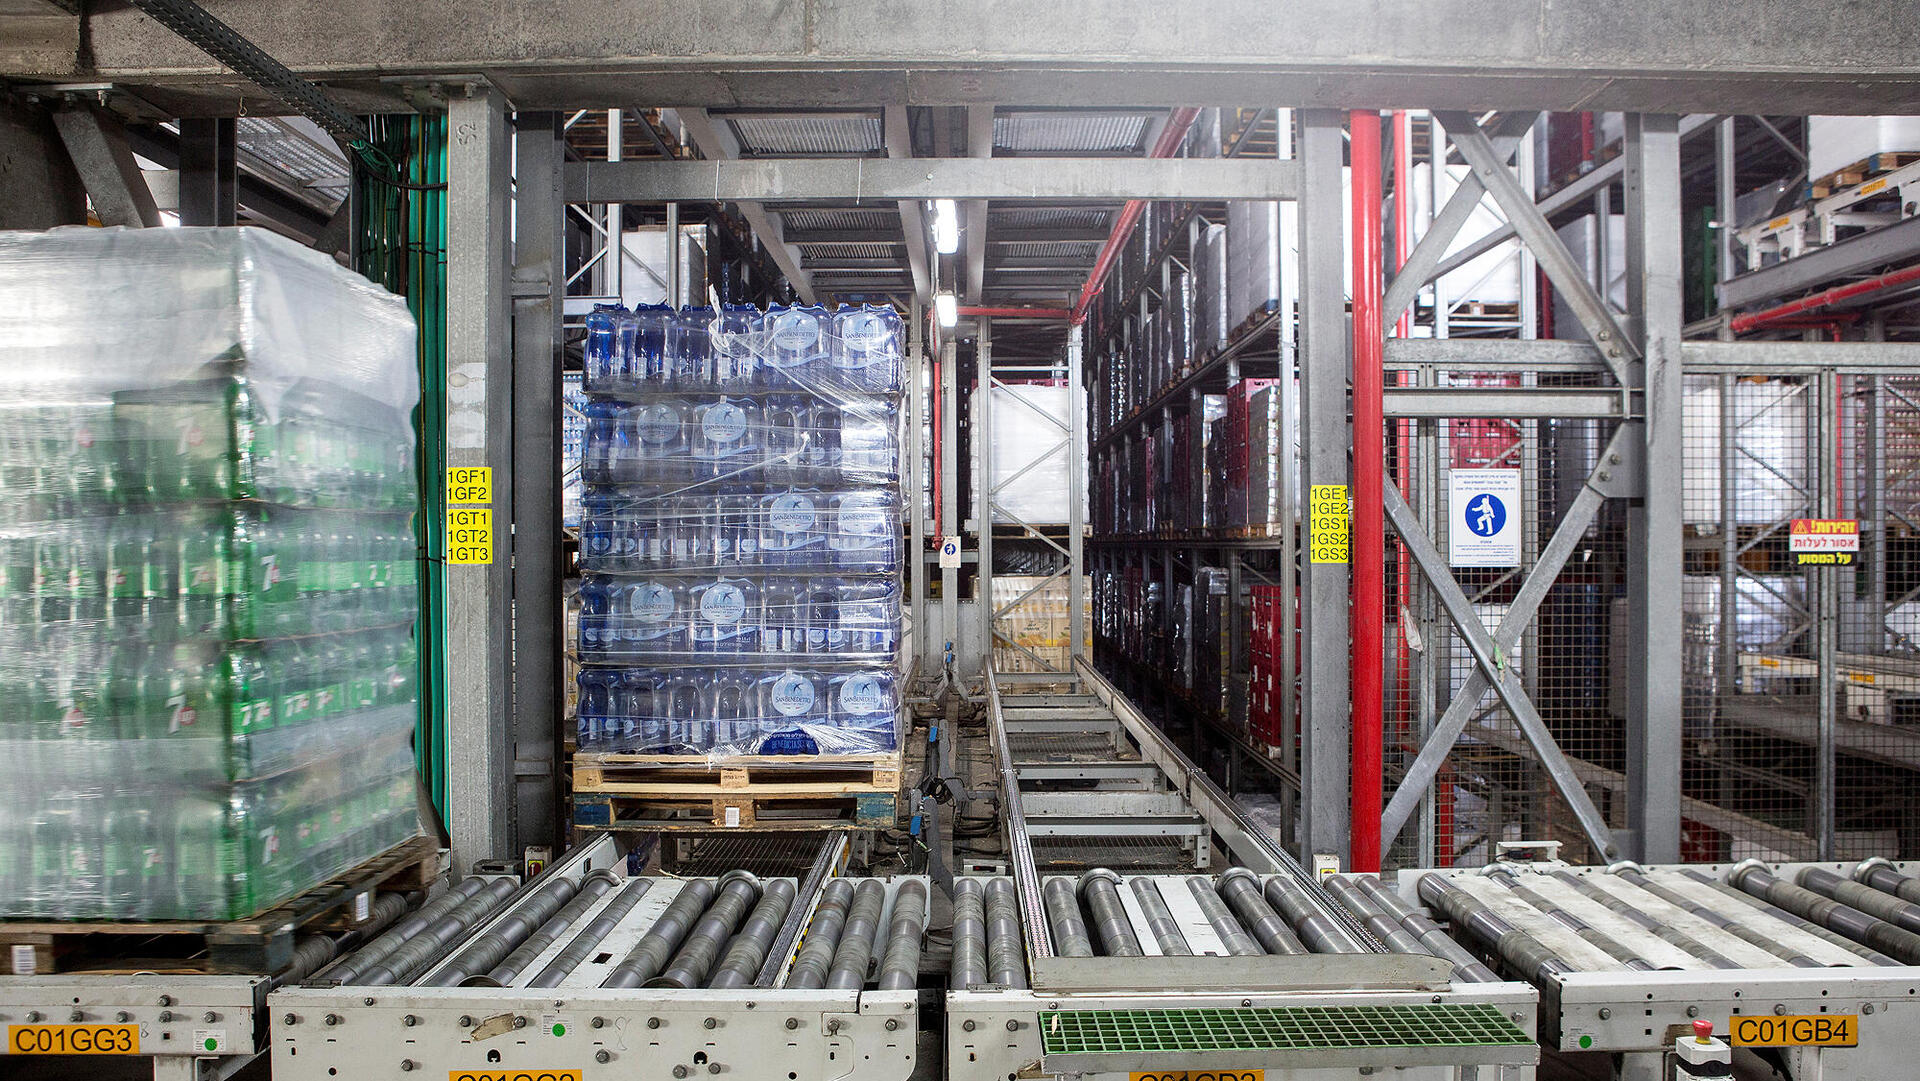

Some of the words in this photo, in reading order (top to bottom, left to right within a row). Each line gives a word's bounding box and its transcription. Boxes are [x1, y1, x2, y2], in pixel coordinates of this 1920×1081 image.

[448, 470, 486, 484] 1GF1
[448, 486, 487, 500] 1GF2
[1312, 487, 1348, 500] 1GE1
[1311, 502, 1349, 515] 1GE2
[448, 511, 487, 525] 1GT1
[1311, 517, 1347, 530] 1GS1
[448, 529, 488, 543] 1GT2
[1310, 532, 1348, 545] 1GS2
[1794, 537, 1827, 548] לעלות
[1829, 538, 1855, 548] אסור
[448, 547, 489, 561] 1GT3
[1310, 547, 1348, 561] 1GS3
[1797, 553, 1836, 565] המסוע
[1836, 552, 1852, 565] על
[1738, 1019, 1849, 1043] C01GB4
[15, 1028, 133, 1052] C01GG3
